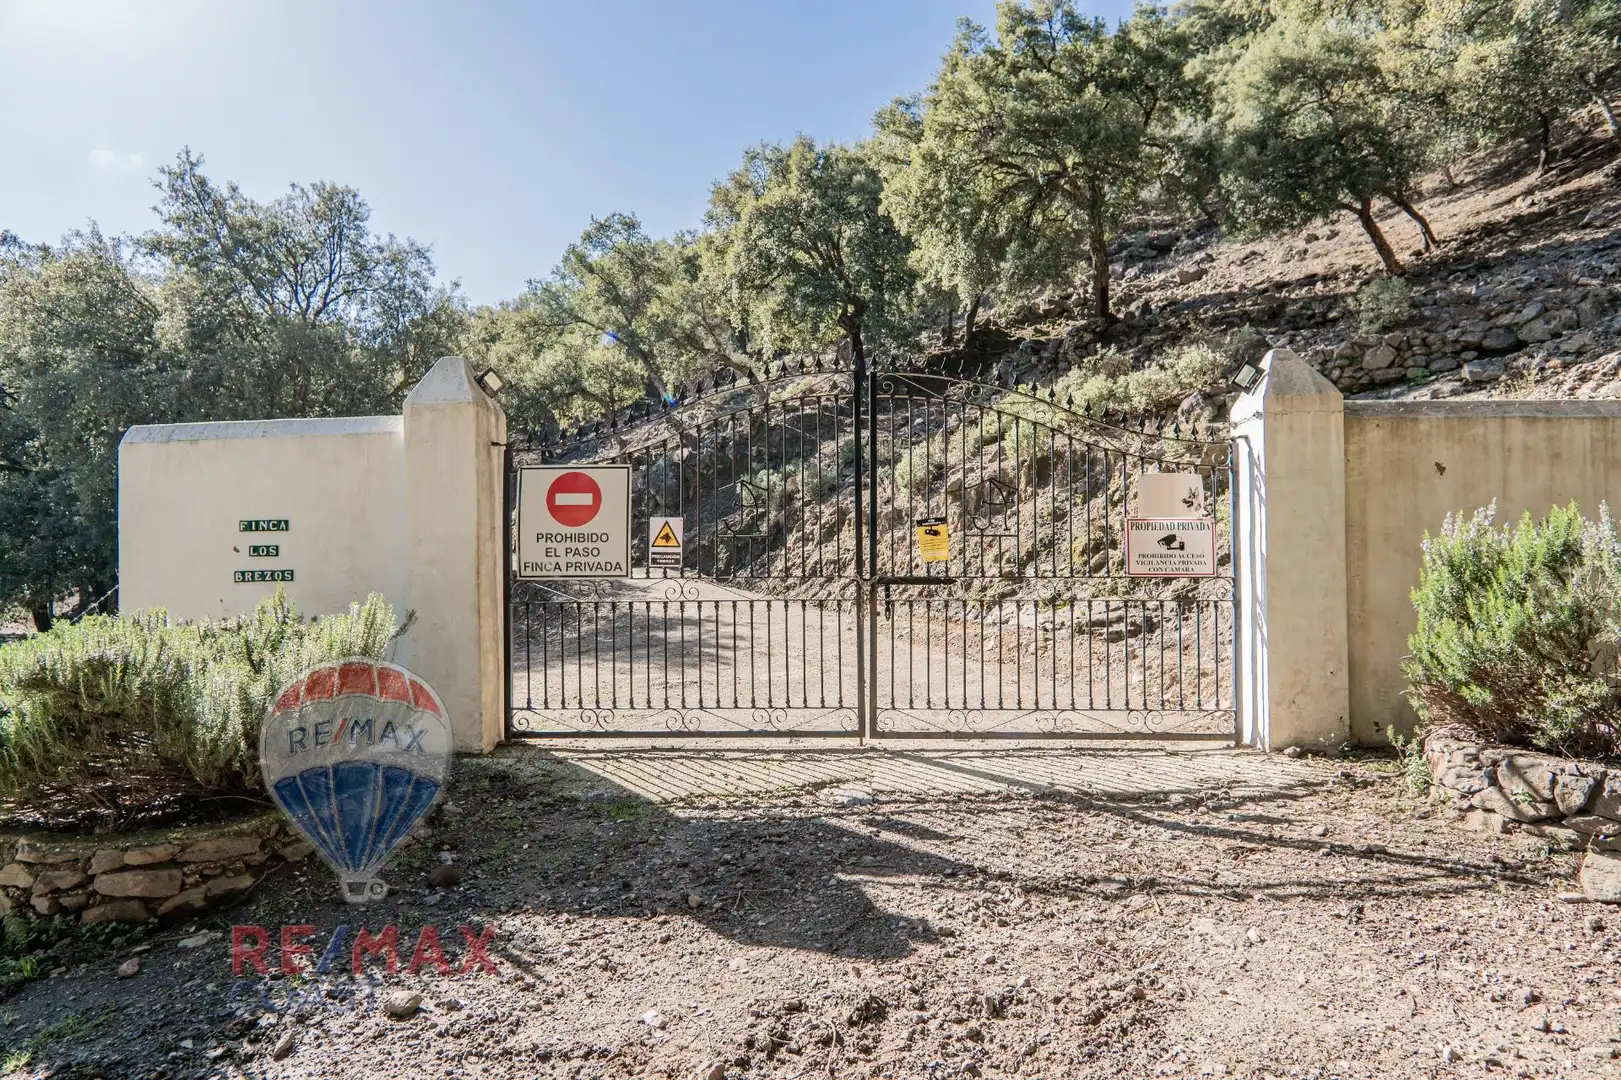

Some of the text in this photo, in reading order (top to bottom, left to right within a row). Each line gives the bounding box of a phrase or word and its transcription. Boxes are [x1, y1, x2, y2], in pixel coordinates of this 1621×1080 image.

[240, 520, 287, 531] FINCA
[1130, 522, 1210, 531] PROPIEDAD PRIVADA
[536, 533, 609, 543] PROHIBIDO
[250, 546, 277, 556] LOS
[545, 547, 600, 558] EL PASO
[523, 561, 623, 572] FINCA PRIVADA
[235, 570, 292, 582] BREZOS
